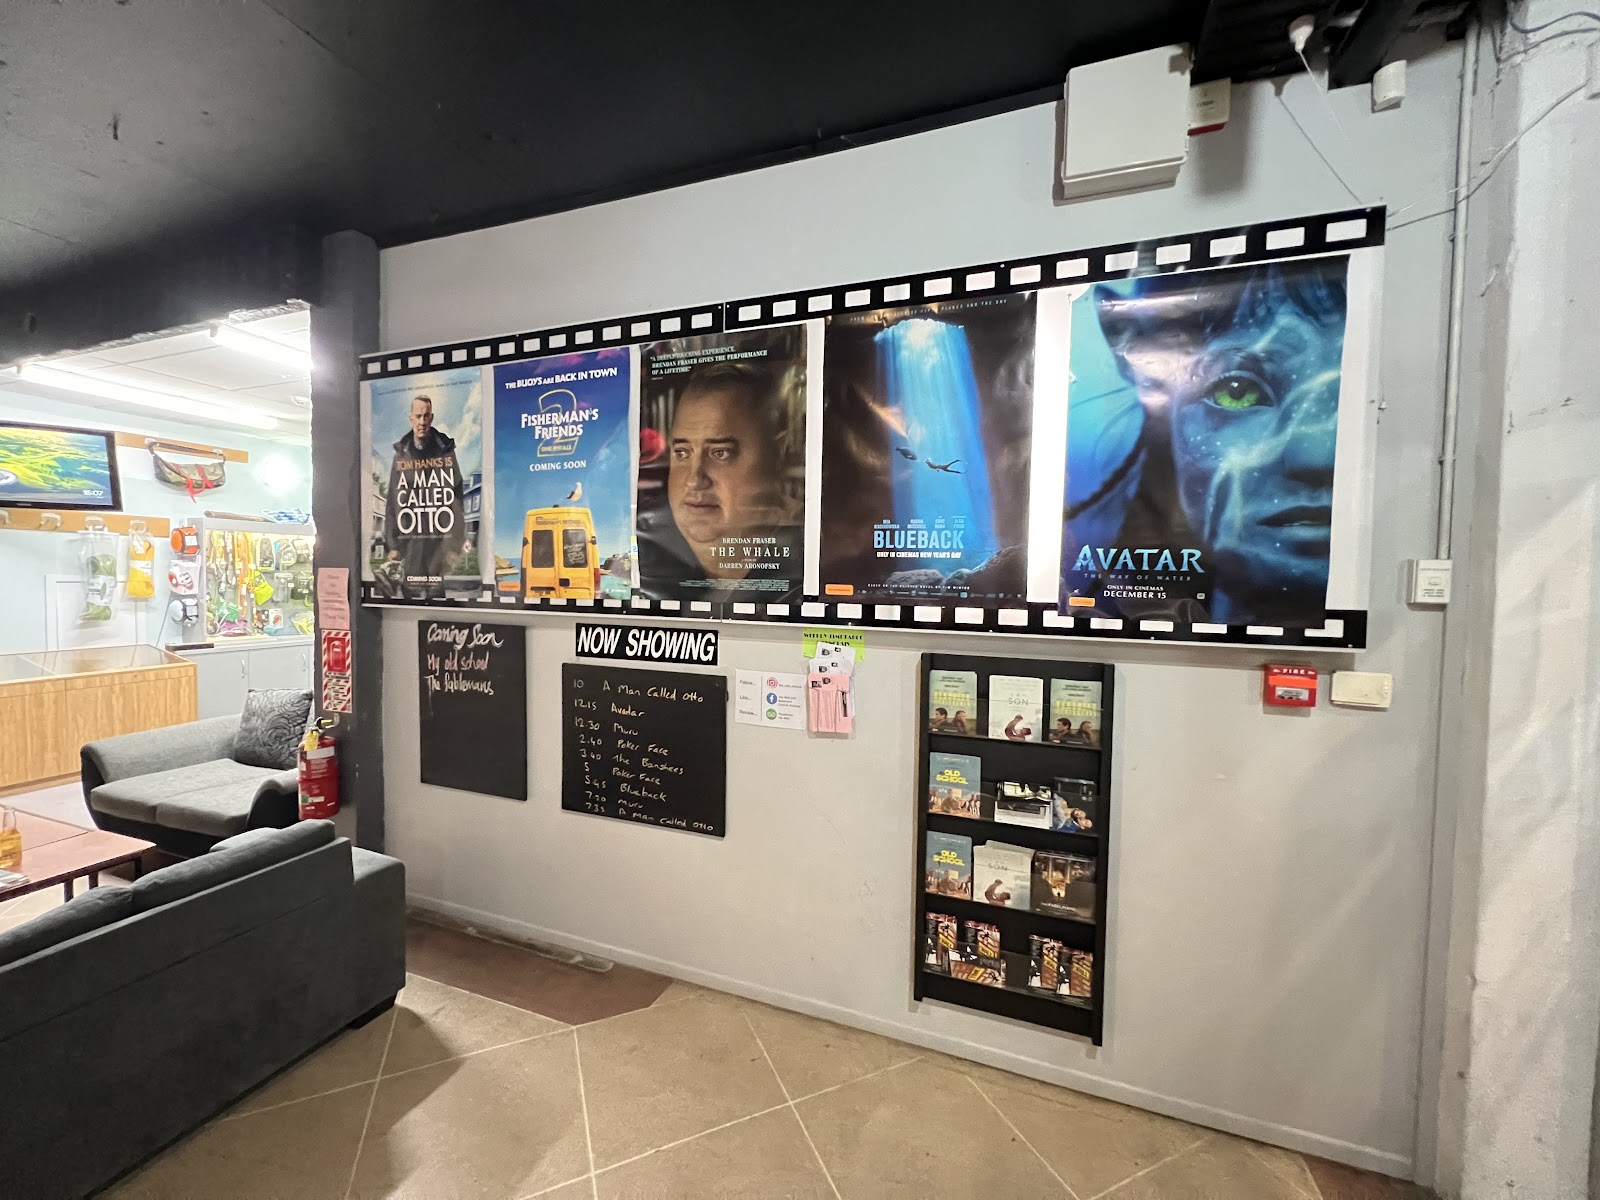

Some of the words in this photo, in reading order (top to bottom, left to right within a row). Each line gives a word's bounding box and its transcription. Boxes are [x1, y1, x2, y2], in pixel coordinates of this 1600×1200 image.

[727, 350, 768, 360] PERFORMANCE
[554, 373, 577, 383] BACK
[578, 371, 588, 380] IN
[588, 367, 618, 379] TOWN
[520, 408, 599, 428] FISHERMAN'S
[534, 424, 584, 440] FRIENDS
[396, 461, 413, 472] TOM
[414, 458, 443, 470] HANKS
[444, 456, 454, 467] IS
[530, 462, 562, 472] COMING
[563, 460, 587, 469] SOON
[396, 472, 408, 490] A
[413, 468, 454, 488] MAN
[397, 488, 454, 508] CALLED
[397, 506, 454, 534] OTTO
[874, 530, 964, 548] BLUEBACK
[710, 546, 735, 557] THE
[743, 546, 790, 558] WHALE
[1070, 544, 1205, 573] AVATAR
[1104, 590, 1154, 599] DECEMBER
[427, 622, 470, 650] Coming
[577, 626, 622, 655] NOW
[625, 628, 716, 662] SHOWING
[427, 654, 440, 676] My
[444, 650, 459, 671] old
[460, 650, 490, 671] school
[424, 674, 441, 693] The
[573, 678, 584, 688] 10
[602, 680, 611, 691] A
[618, 686, 641, 696] Man
[646, 686, 677, 700] Called
[610, 702, 646, 717] Avatar
[1008, 698, 1029, 706] SON
[614, 722, 639, 736] Muru
[579, 733, 602, 746] 2.40
[617, 739, 640, 750] Poker
[648, 744, 669, 756] Face
[612, 754, 630, 765] The
[641, 758, 684, 775] Banshees
[612, 767, 636, 779] Poker
[639, 773, 661, 786] Face
[936, 774, 968, 784] SCHOOL
[620, 782, 668, 802] Blueback
[618, 808, 626, 816] A
[932, 854, 966, 866] SCHOOL
[941, 850, 957, 858] OLD
